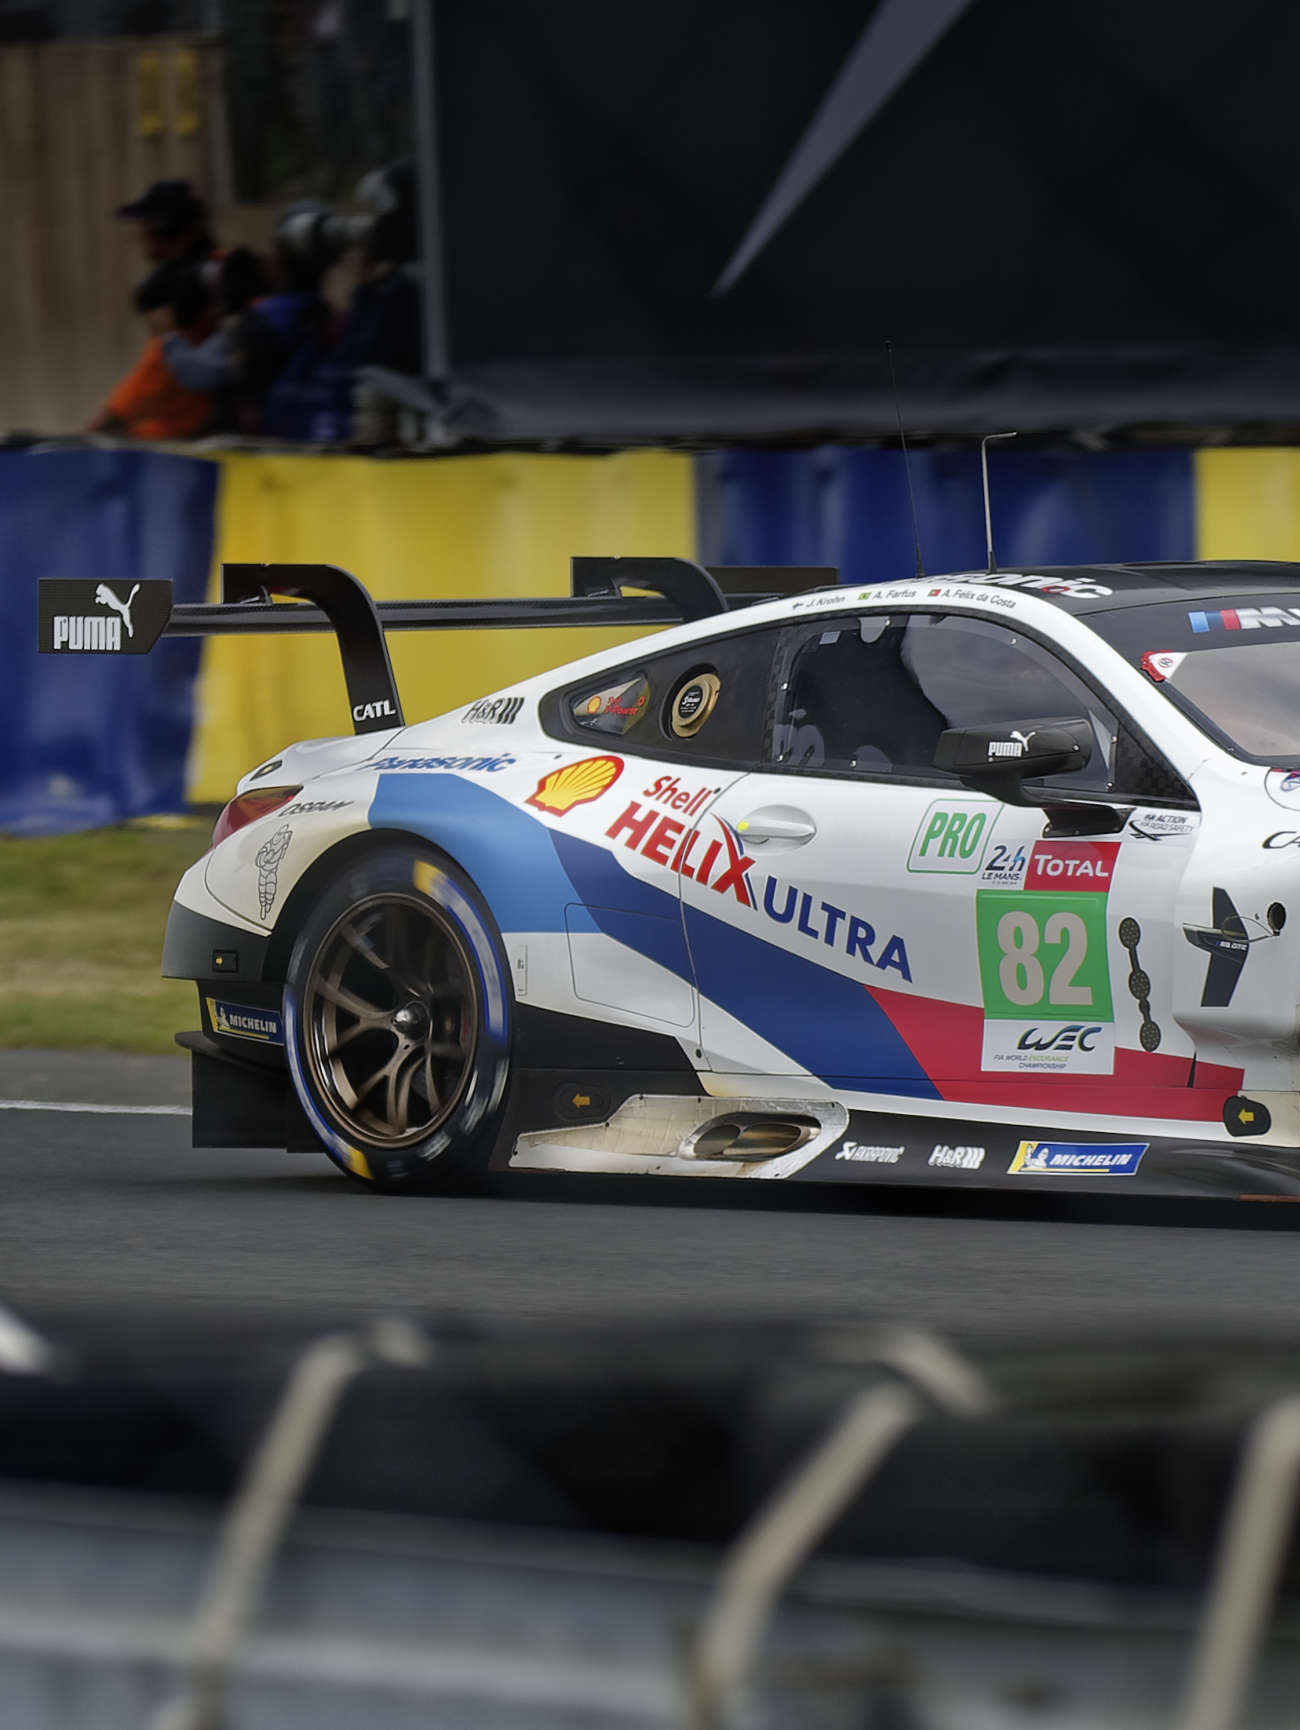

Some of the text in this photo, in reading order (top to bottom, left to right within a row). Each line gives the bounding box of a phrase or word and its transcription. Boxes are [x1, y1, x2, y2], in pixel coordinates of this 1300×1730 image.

[873, 591, 883, 600] A.
[942, 588, 952, 598] A.
[976, 591, 989, 602] da
[990, 595, 1016, 609] Costa
[53, 615, 121, 651] PUMA
[353, 700, 397, 722] CATL
[988, 741, 1023, 757] PUMA
[358, 753, 516, 773] Panasonic
[642, 775, 713, 817] Shell
[1156, 815, 1188, 824] ACTION
[919, 811, 988, 860] PRO
[981, 872, 1021, 881] LE MANS
[1034, 854, 1110, 878] TOTAL
[605, 800, 913, 984] HELIX ULTRA
[997, 910, 1094, 1007] 82
[228, 1013, 278, 1034] MICHELIN
[1017, 1024, 1103, 1052] WEC
[1049, 1153, 1132, 1168] MICHELIN
